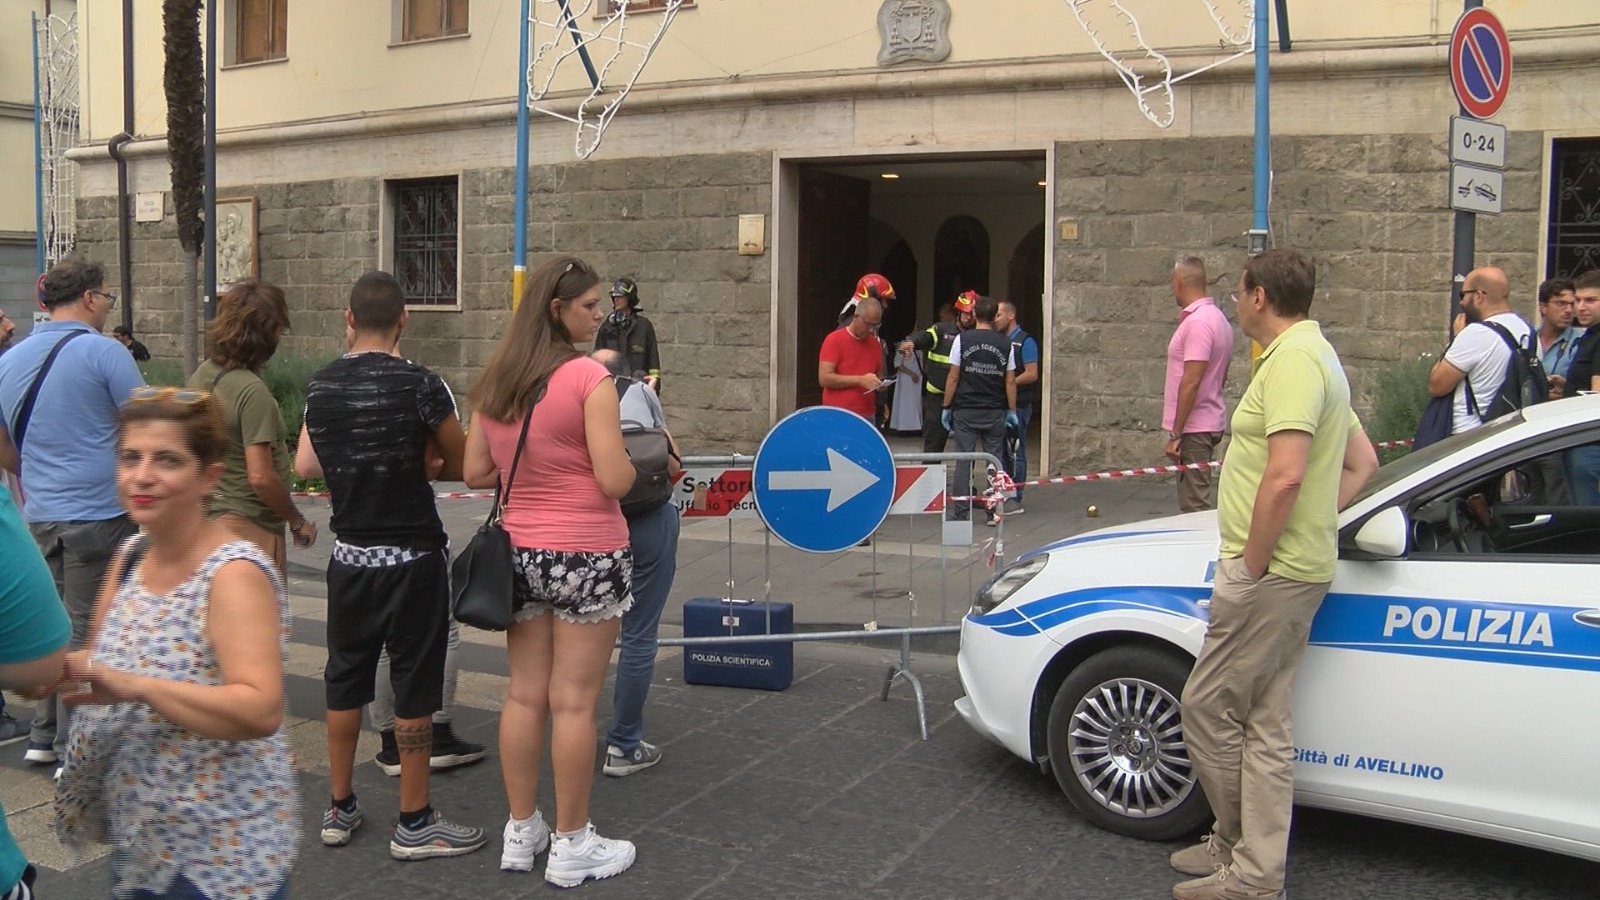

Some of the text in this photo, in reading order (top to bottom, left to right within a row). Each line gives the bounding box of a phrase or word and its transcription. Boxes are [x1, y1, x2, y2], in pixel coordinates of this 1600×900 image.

[1463, 132, 1495, 153] 0-24
[676, 499, 720, 511] Uffio
[1382, 604, 1554, 647] POLIZIA
[692, 653, 771, 667] POLIZIA SCIENTIFICA
[1333, 753, 1350, 767] di
[1354, 756, 1444, 781] AVELLINO
[508, 837, 523, 845] FILA
